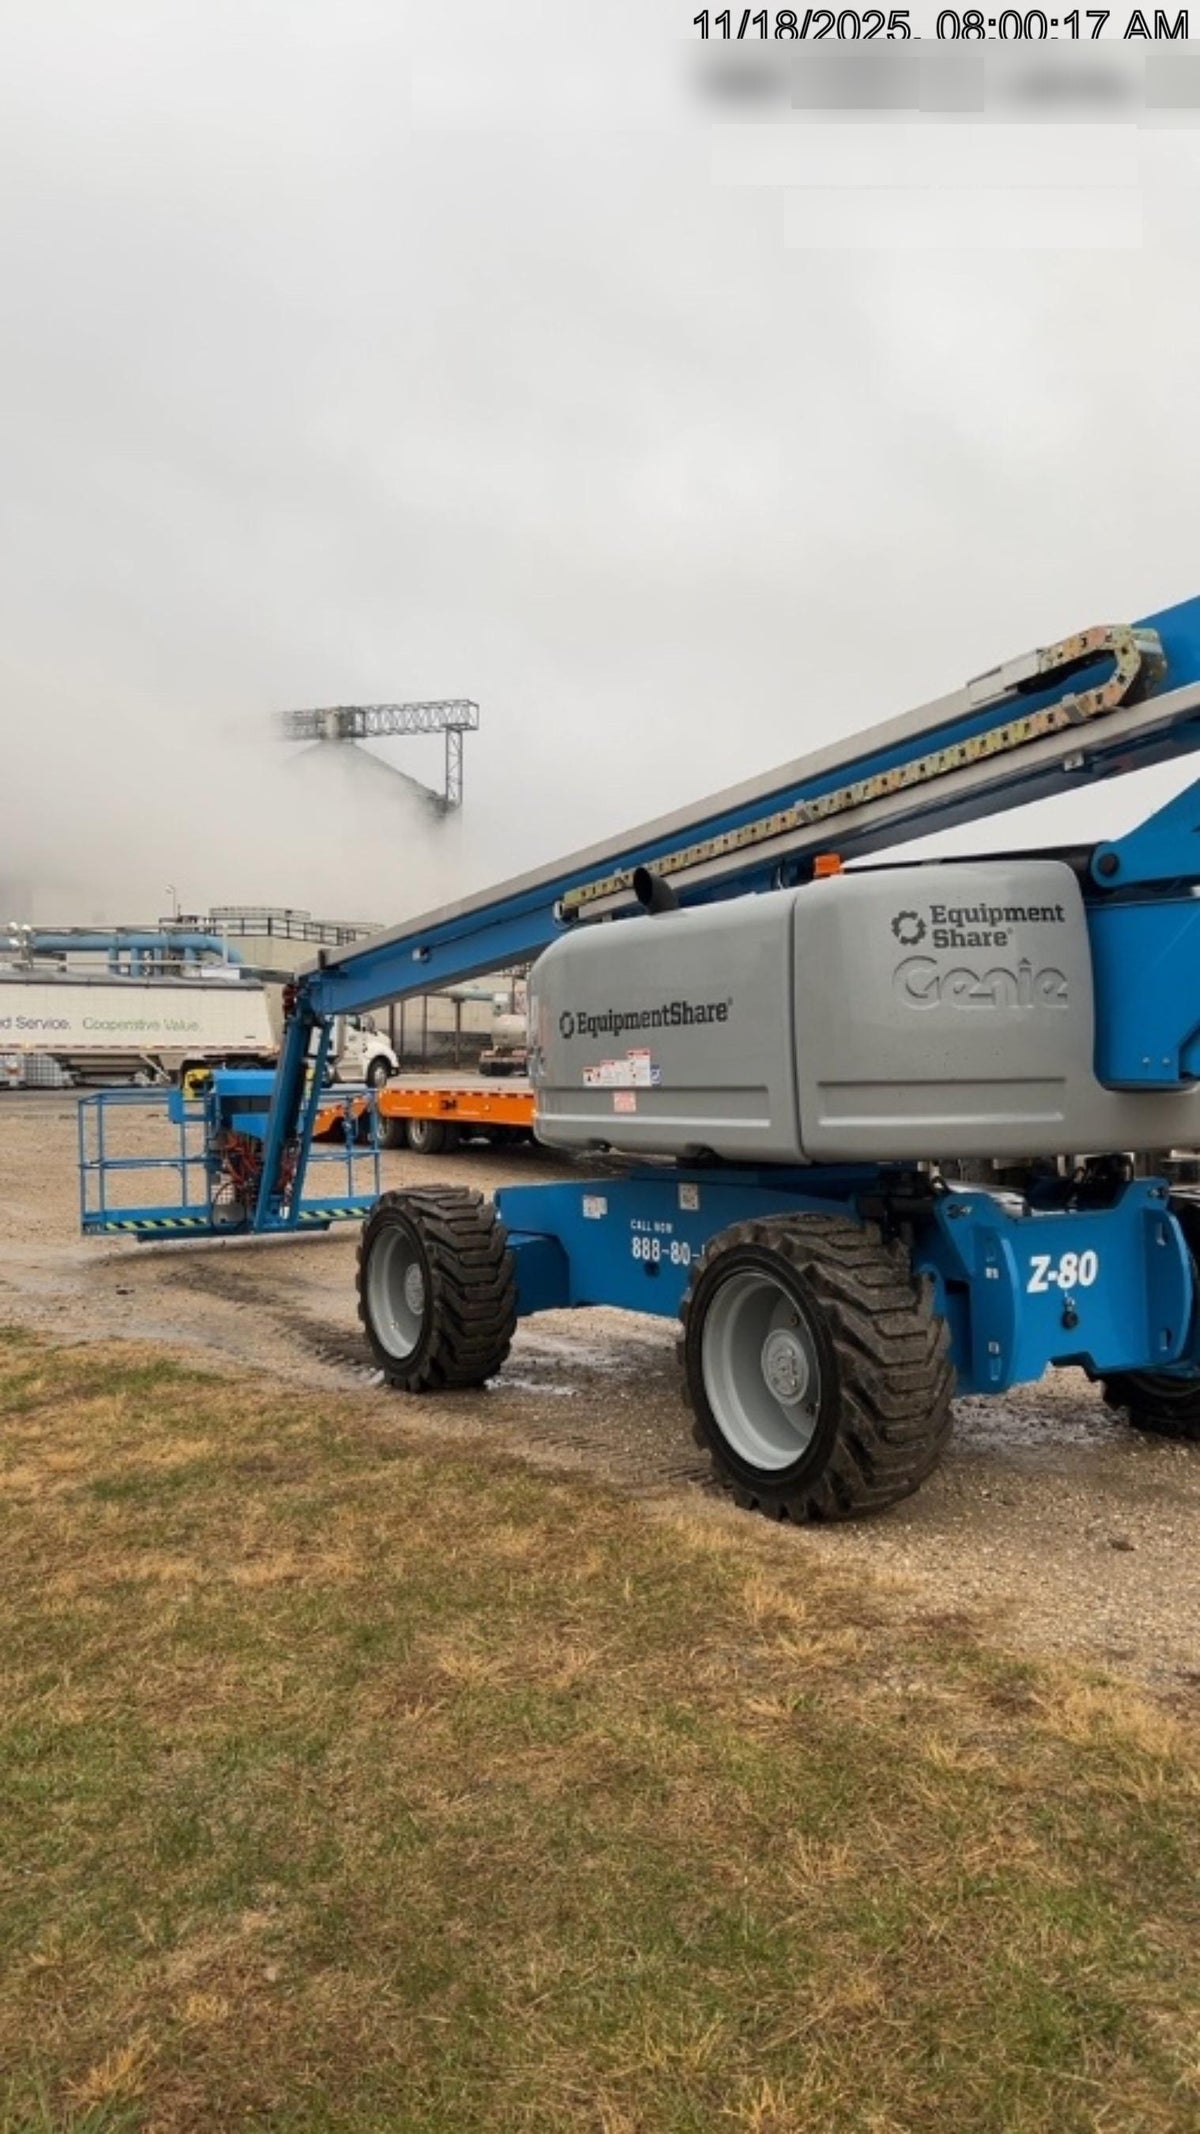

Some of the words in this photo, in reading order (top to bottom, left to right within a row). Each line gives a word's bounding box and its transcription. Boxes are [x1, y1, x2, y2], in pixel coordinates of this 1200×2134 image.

[929, 903, 1066, 927] Equipment
[932, 929, 1008, 949] Share
[892, 955, 1069, 1010] Genie
[15, 1016, 72, 1031] Service.
[82, 1017, 161, 1032] Cooperative
[576, 1001, 729, 1037] EquipmentShare
[630, 1219, 652, 1232] CALL
[654, 1221, 673, 1234] NOW
[632, 1236, 706, 1267] 888-80-
[1026, 1250, 1098, 1293] Z-80
